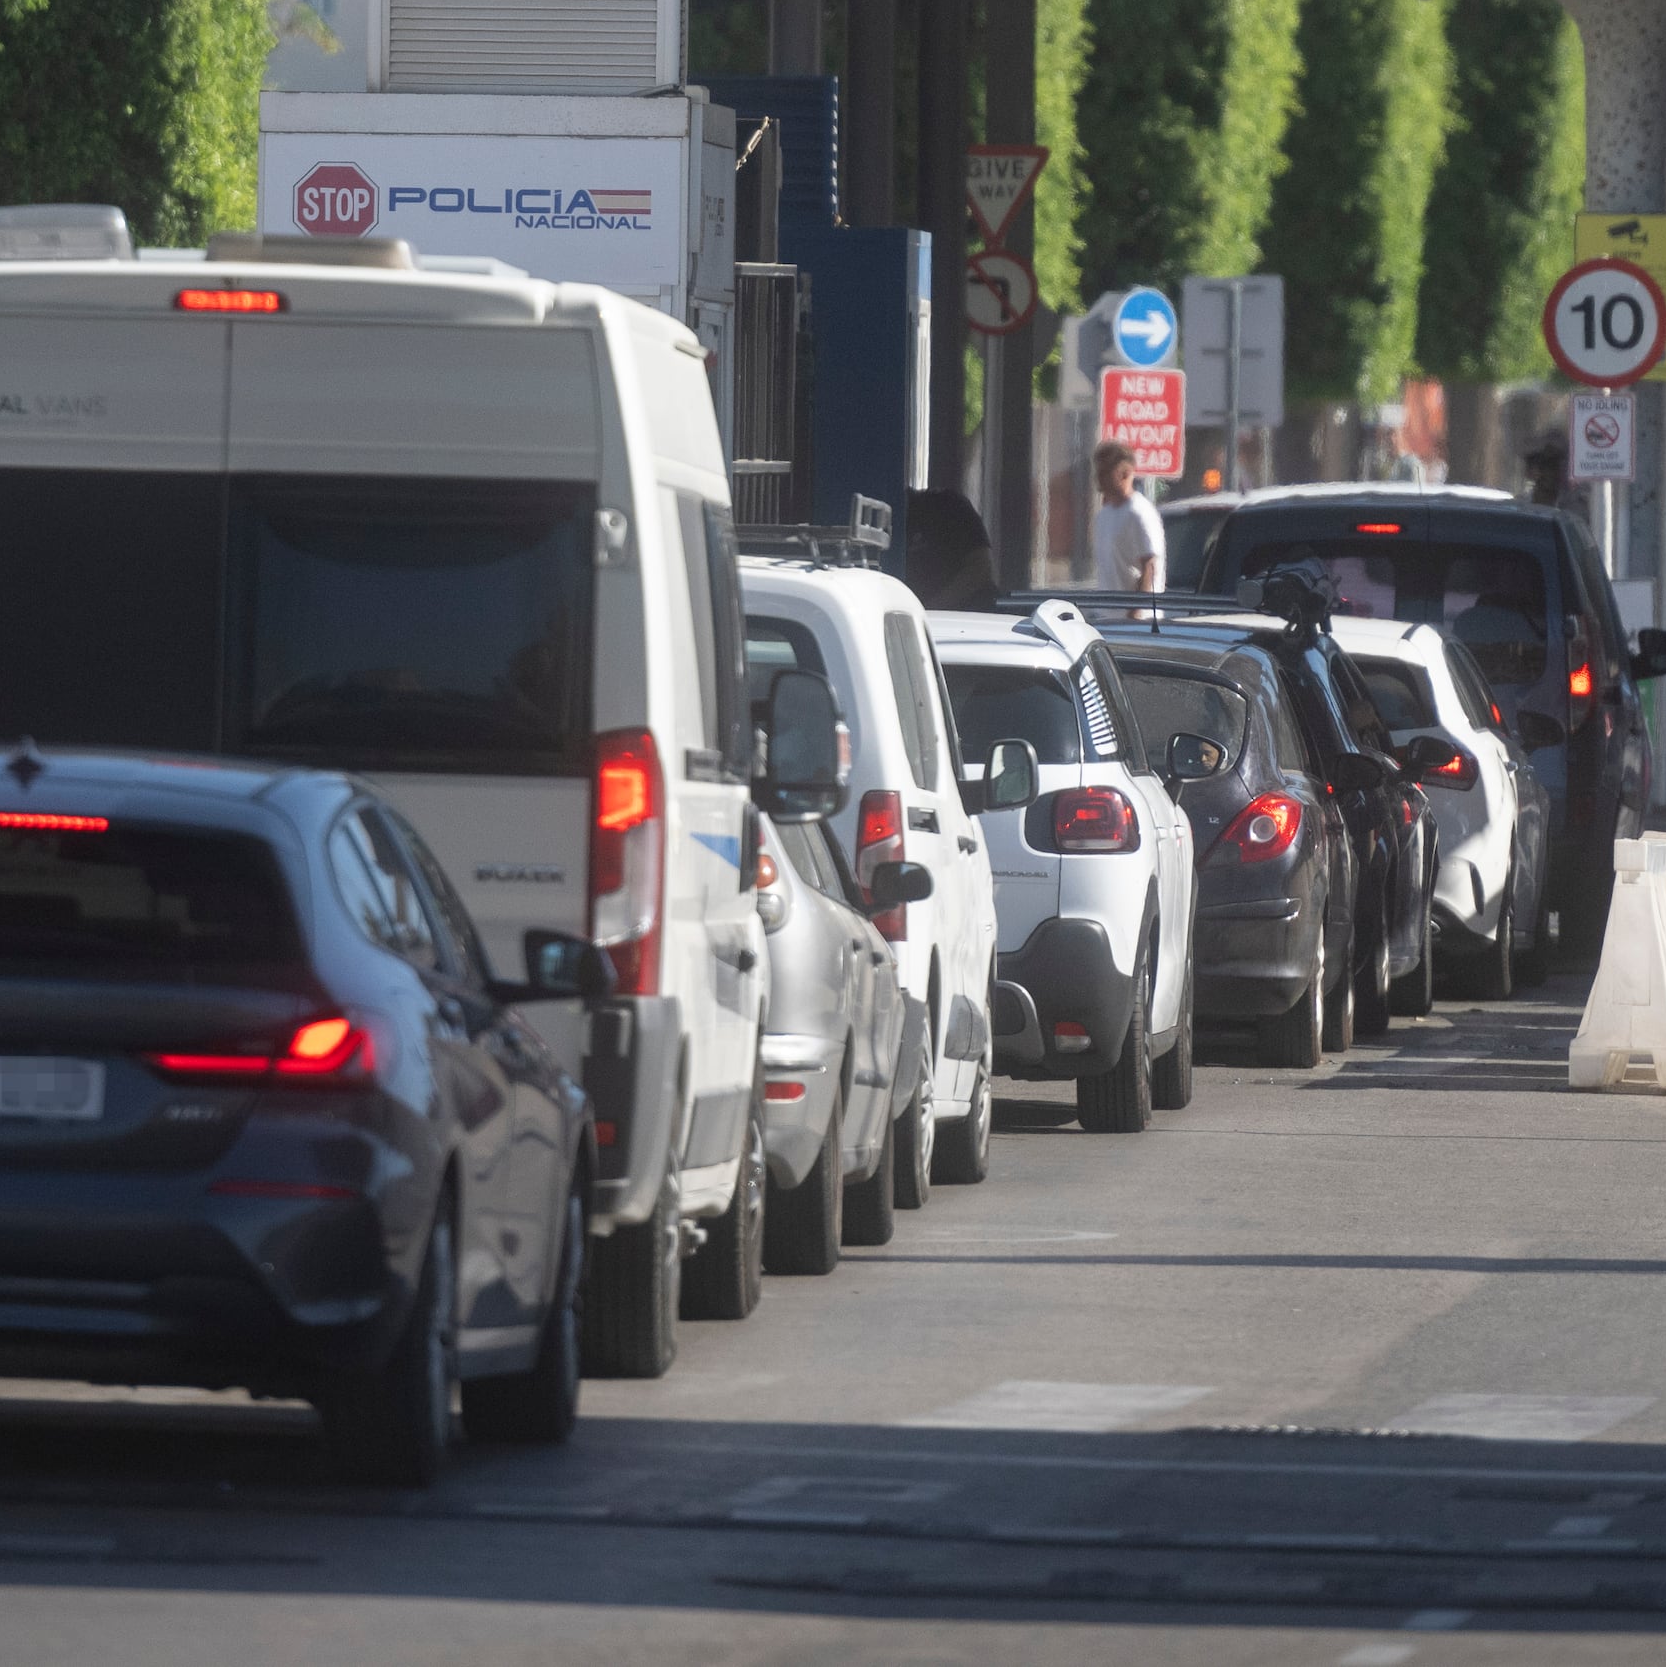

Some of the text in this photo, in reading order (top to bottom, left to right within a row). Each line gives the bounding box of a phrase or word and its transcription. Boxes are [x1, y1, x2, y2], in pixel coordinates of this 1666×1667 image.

[969, 158, 1024, 179] GIVE
[388, 187, 597, 215] POLICÍA
[979, 185, 1017, 197] WAY
[302, 186, 370, 222] STOP
[515, 215, 652, 230] NACIONAL
[1571, 294, 1645, 350] 10
[1121, 375, 1166, 395] NEW
[37, 394, 109, 417] VANS
[1115, 399, 1169, 421] ROAD
[1578, 398, 1628, 412] NO IDLING
